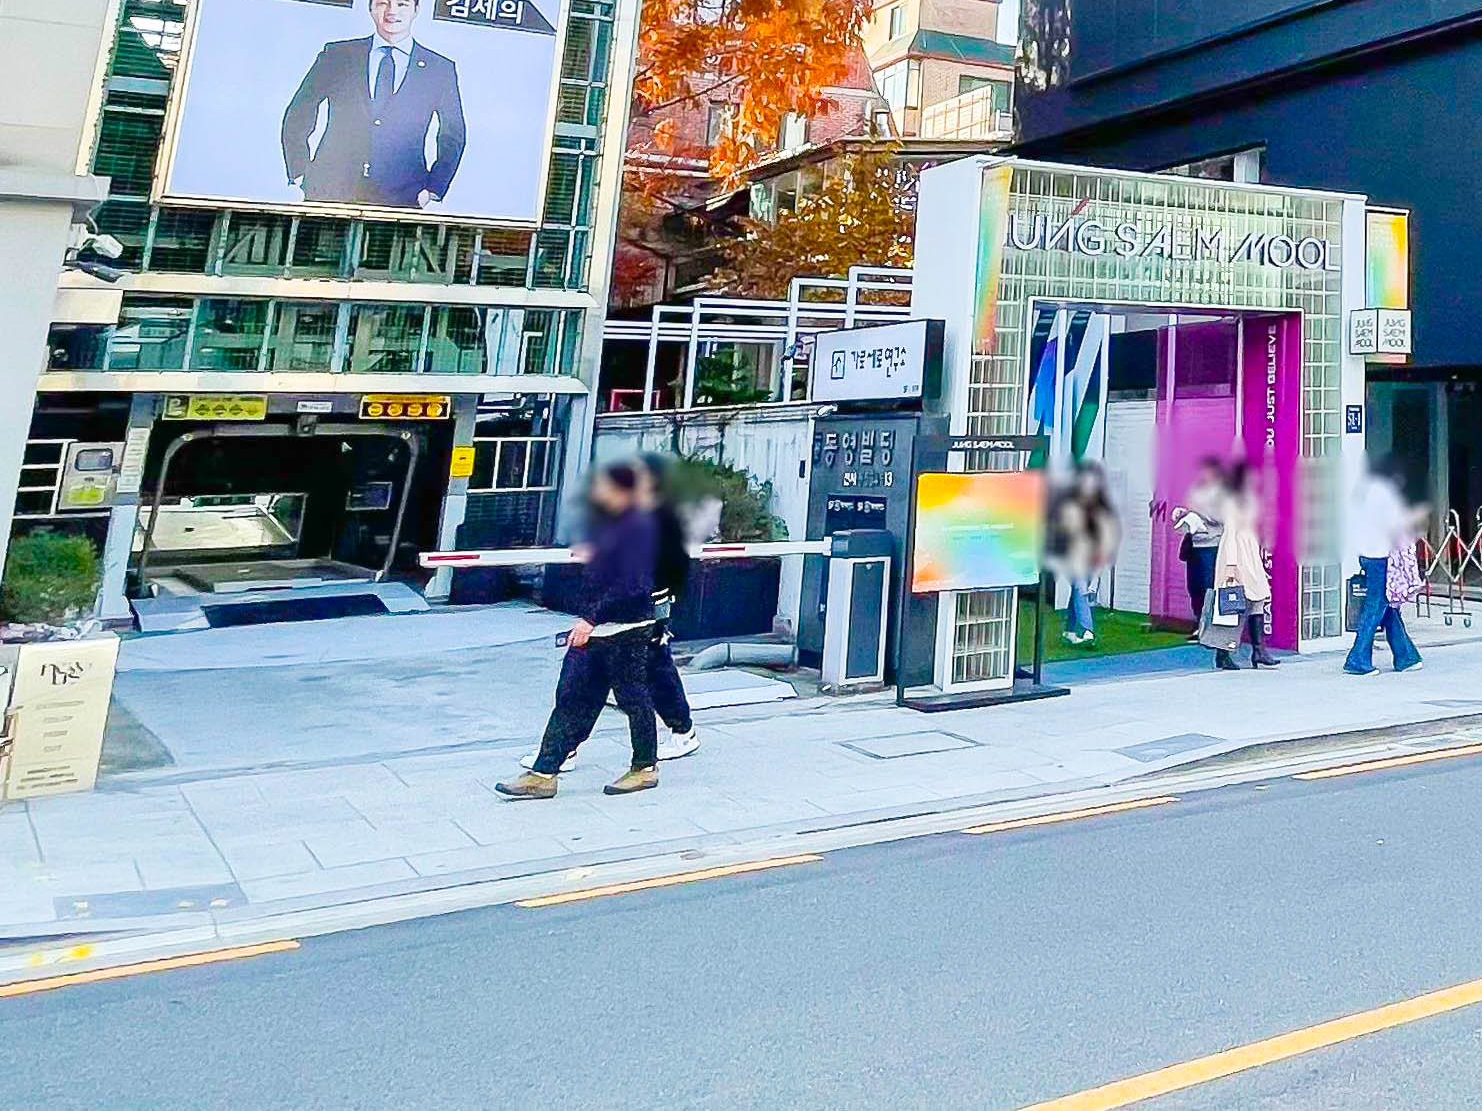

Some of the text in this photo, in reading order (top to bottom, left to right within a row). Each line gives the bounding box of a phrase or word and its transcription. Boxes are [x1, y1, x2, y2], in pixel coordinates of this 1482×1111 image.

[1229, 232, 1341, 272] MOOL
[1267, 324, 1277, 385] BELIEVE
[1266, 386, 1276, 424] JUST
[823, 429, 896, 467] 동영빌딩
